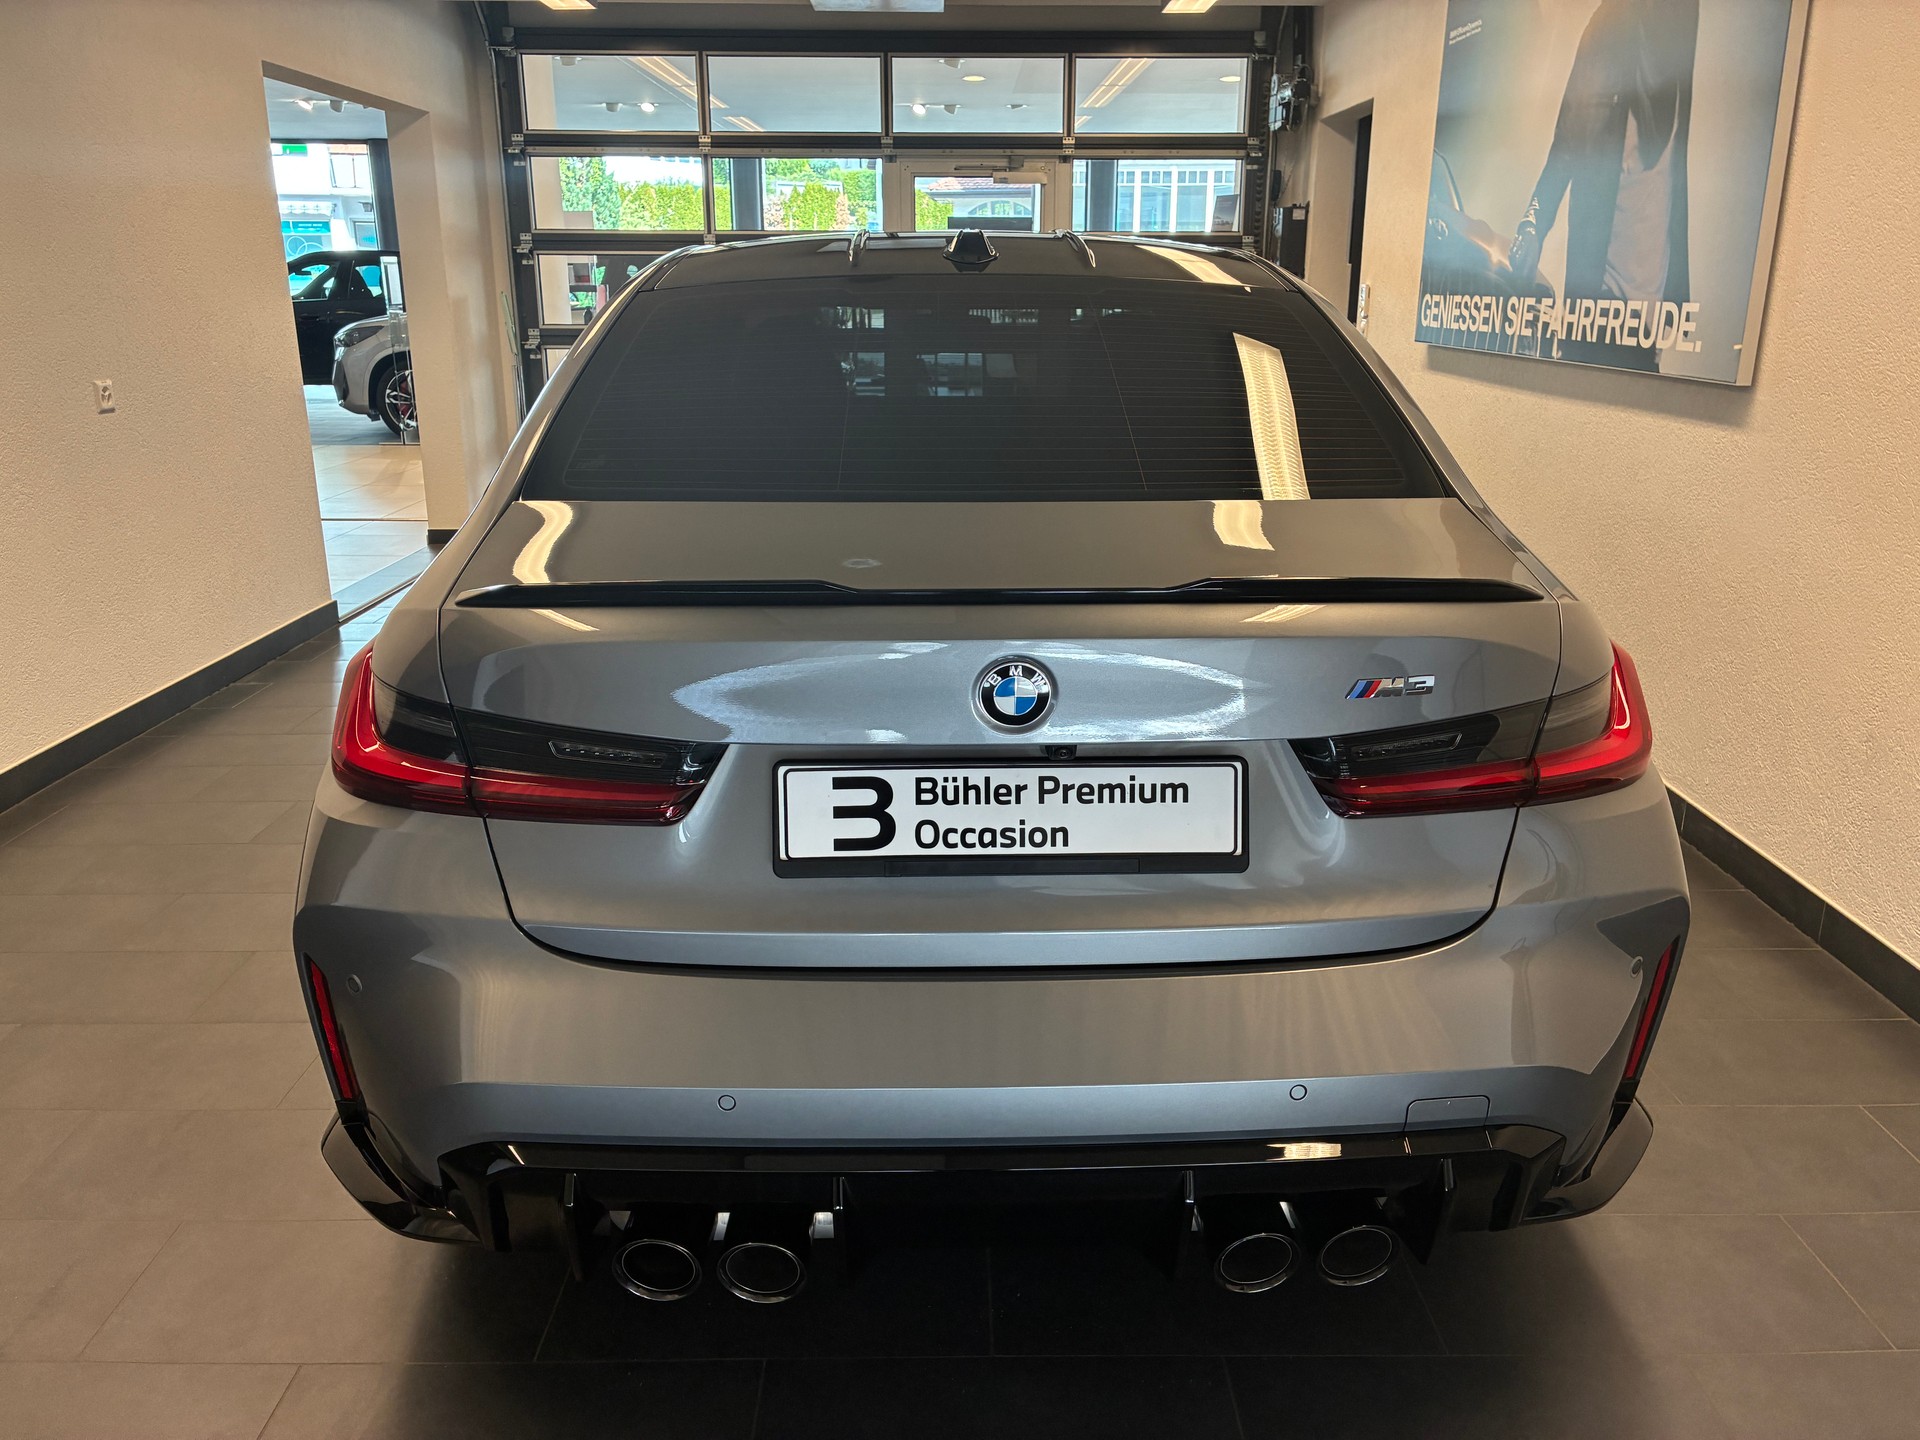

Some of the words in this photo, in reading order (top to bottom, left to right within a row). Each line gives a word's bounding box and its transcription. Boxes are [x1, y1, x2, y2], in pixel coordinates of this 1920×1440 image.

[1421, 293, 1503, 334] GENIESSEN
[1504, 296, 1536, 337] SIE
[1537, 297, 1702, 353] FAHRFREUDE.
[987, 665, 1046, 687] BMW
[1363, 675, 1435, 698] M3
[915, 776, 1028, 806] Bühler
[1038, 775, 1190, 805] Premium
[915, 819, 1070, 849] Occasion
